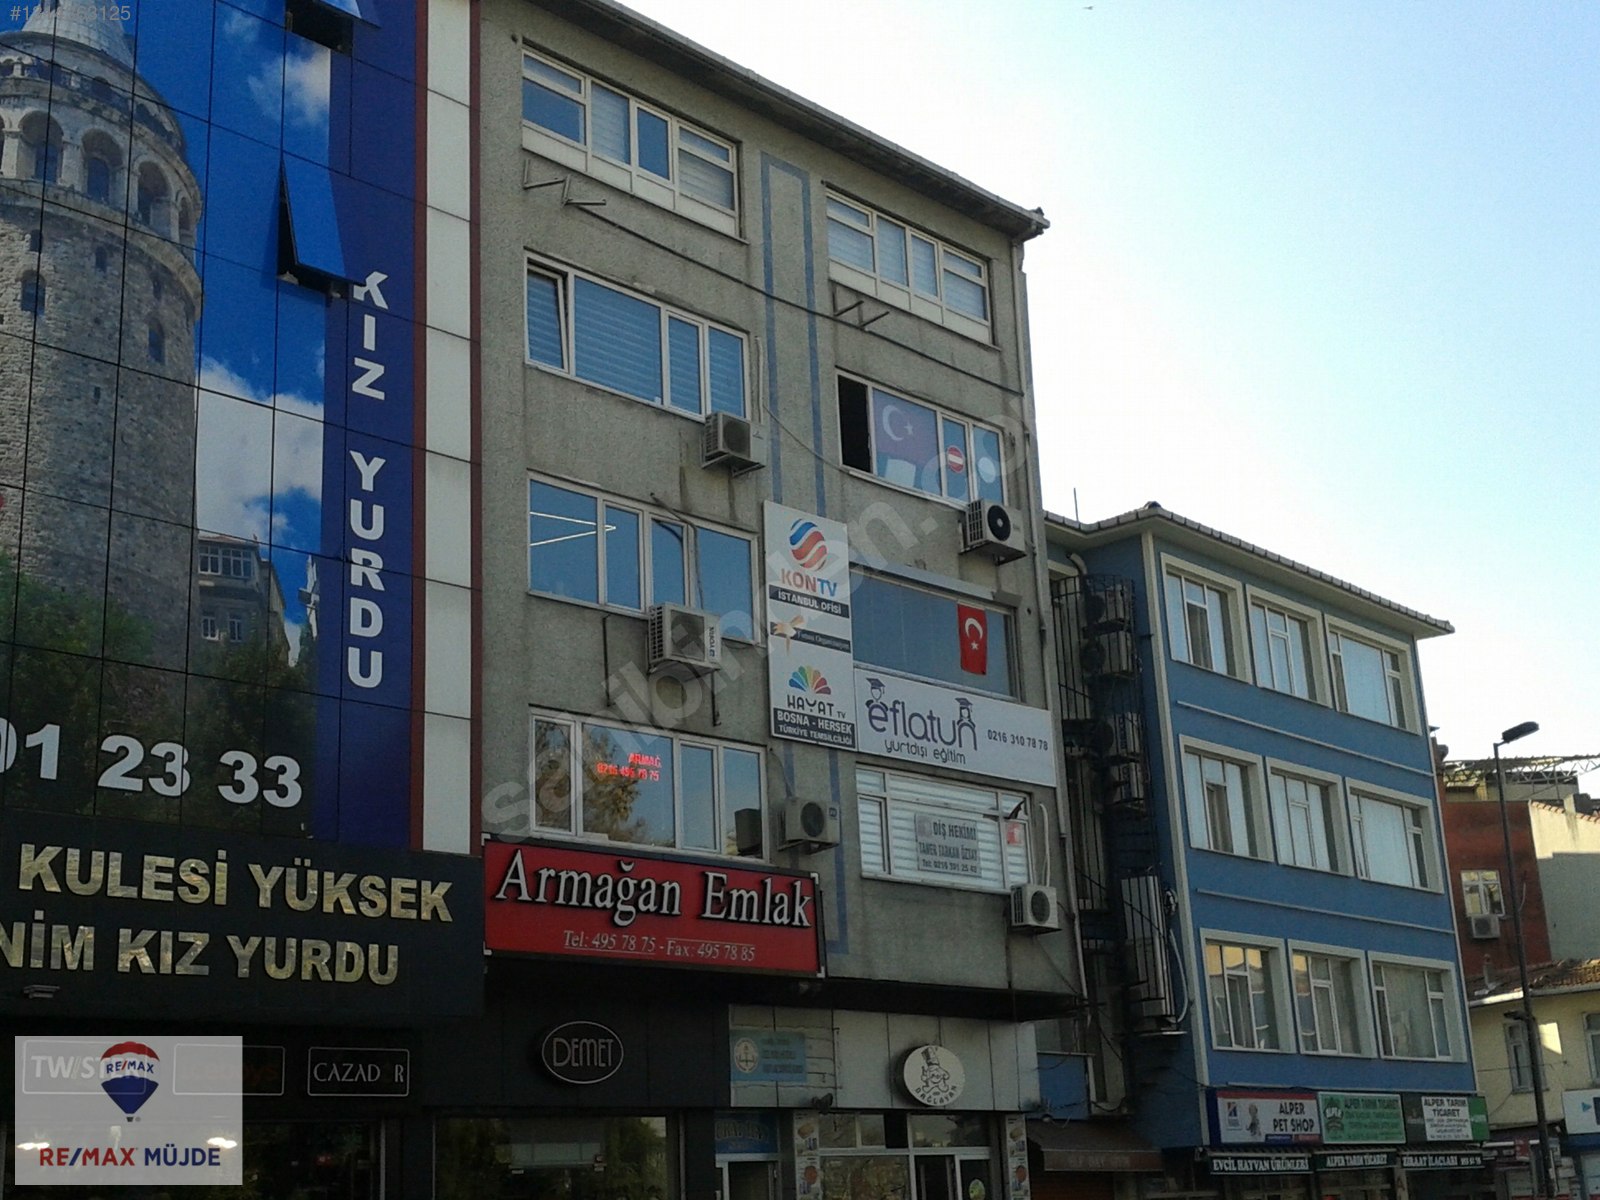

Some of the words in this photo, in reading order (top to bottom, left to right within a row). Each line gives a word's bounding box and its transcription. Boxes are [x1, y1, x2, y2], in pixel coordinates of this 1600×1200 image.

[347, 450, 387, 689] YURDU
[780, 568, 838, 598] KONTV
[778, 589, 819, 609] İSTANBUL
[820, 601, 842, 615] OFİSİ
[786, 694, 835, 717] HAYAT
[836, 710, 847, 719] TV
[776, 710, 810, 727] BOSNA
[817, 718, 853, 736] HERSEK
[778, 722, 808, 738] TÜRKİYE
[867, 699, 978, 751] eflatun
[884, 739, 929, 759] yurtdışı
[932, 748, 967, 765] eğitim
[987, 729, 1008, 744] 0216
[1010, 733, 1026, 747] 310
[1027, 737, 1038, 749] 78
[1038, 738, 1049, 751] 78
[97, 733, 192, 798] 23
[216, 749, 303, 810] 33
[18, 843, 229, 907] KULESİ
[247, 857, 454, 923] YÜKSEK
[495, 848, 683, 927] Armağan
[701, 871, 813, 928] Emlak
[116, 928, 211, 977] KIZ
[226, 934, 400, 986] YURDU
[563, 930, 589, 948] Tel:
[591, 932, 617, 950] 495
[621, 935, 637, 951] 78
[641, 936, 657, 953] 75
[696, 942, 720, 959] 495
[723, 944, 739, 961] 78
[740, 945, 756, 962] 85
[552, 1037, 614, 1068] DEMET
[1279, 1102, 1305, 1115] ALPER
[1272, 1118, 1288, 1132] PET
[1289, 1118, 1315, 1133] SHOP
